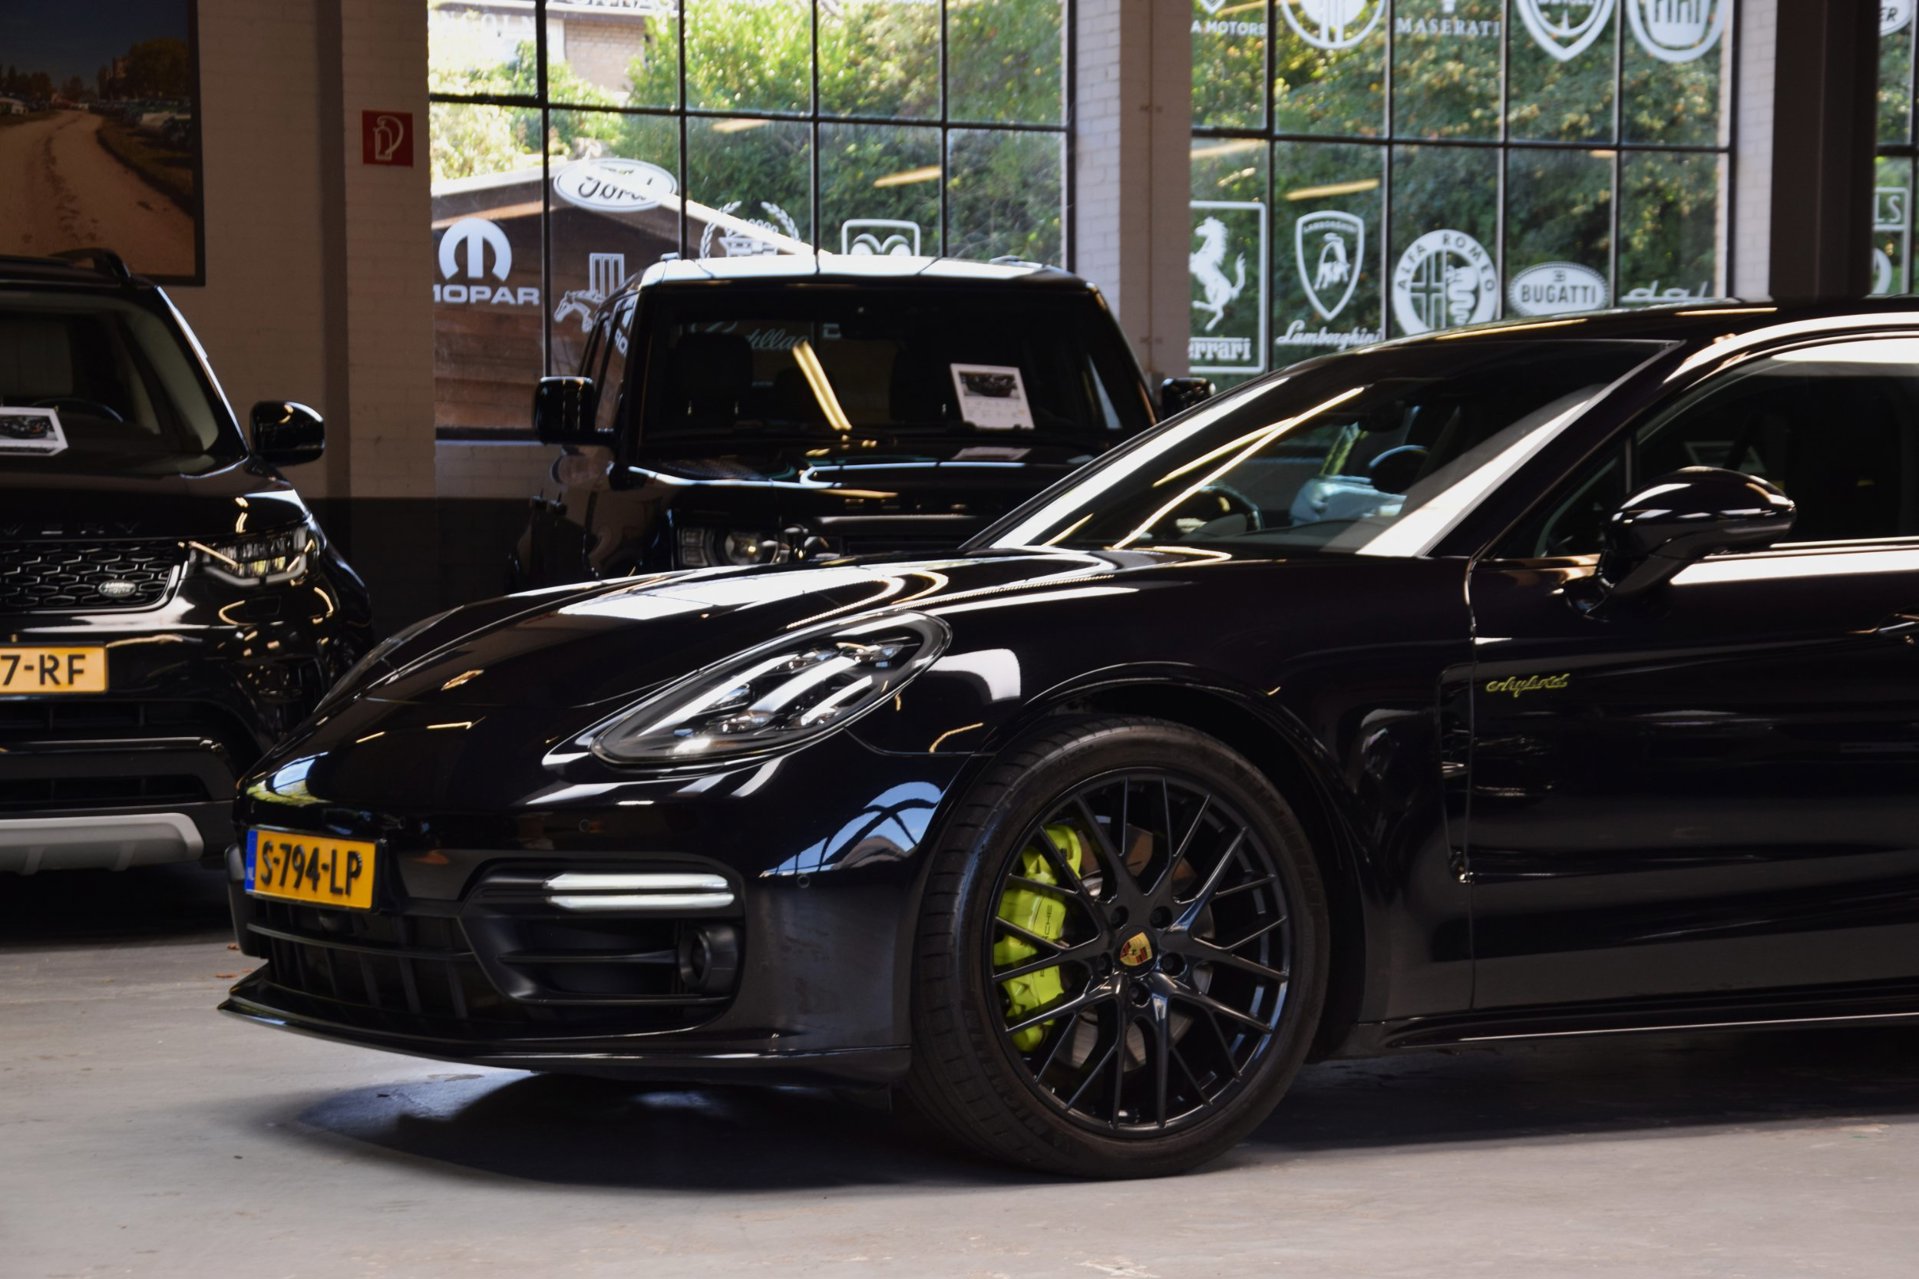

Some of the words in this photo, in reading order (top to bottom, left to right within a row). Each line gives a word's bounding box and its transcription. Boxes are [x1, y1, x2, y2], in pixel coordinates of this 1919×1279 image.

[1206, 21, 1266, 36] MOTORS
[1394, 17, 1501, 37] MASERATI
[1398, 244, 1427, 290] ALFA
[1442, 233, 1496, 292] ROMEO
[1521, 285, 1596, 304] BUGATTI
[1275, 320, 1383, 350] Lamborghini
[0, 654, 86, 686] 7-RF
[261, 840, 363, 896] S-794-LP
